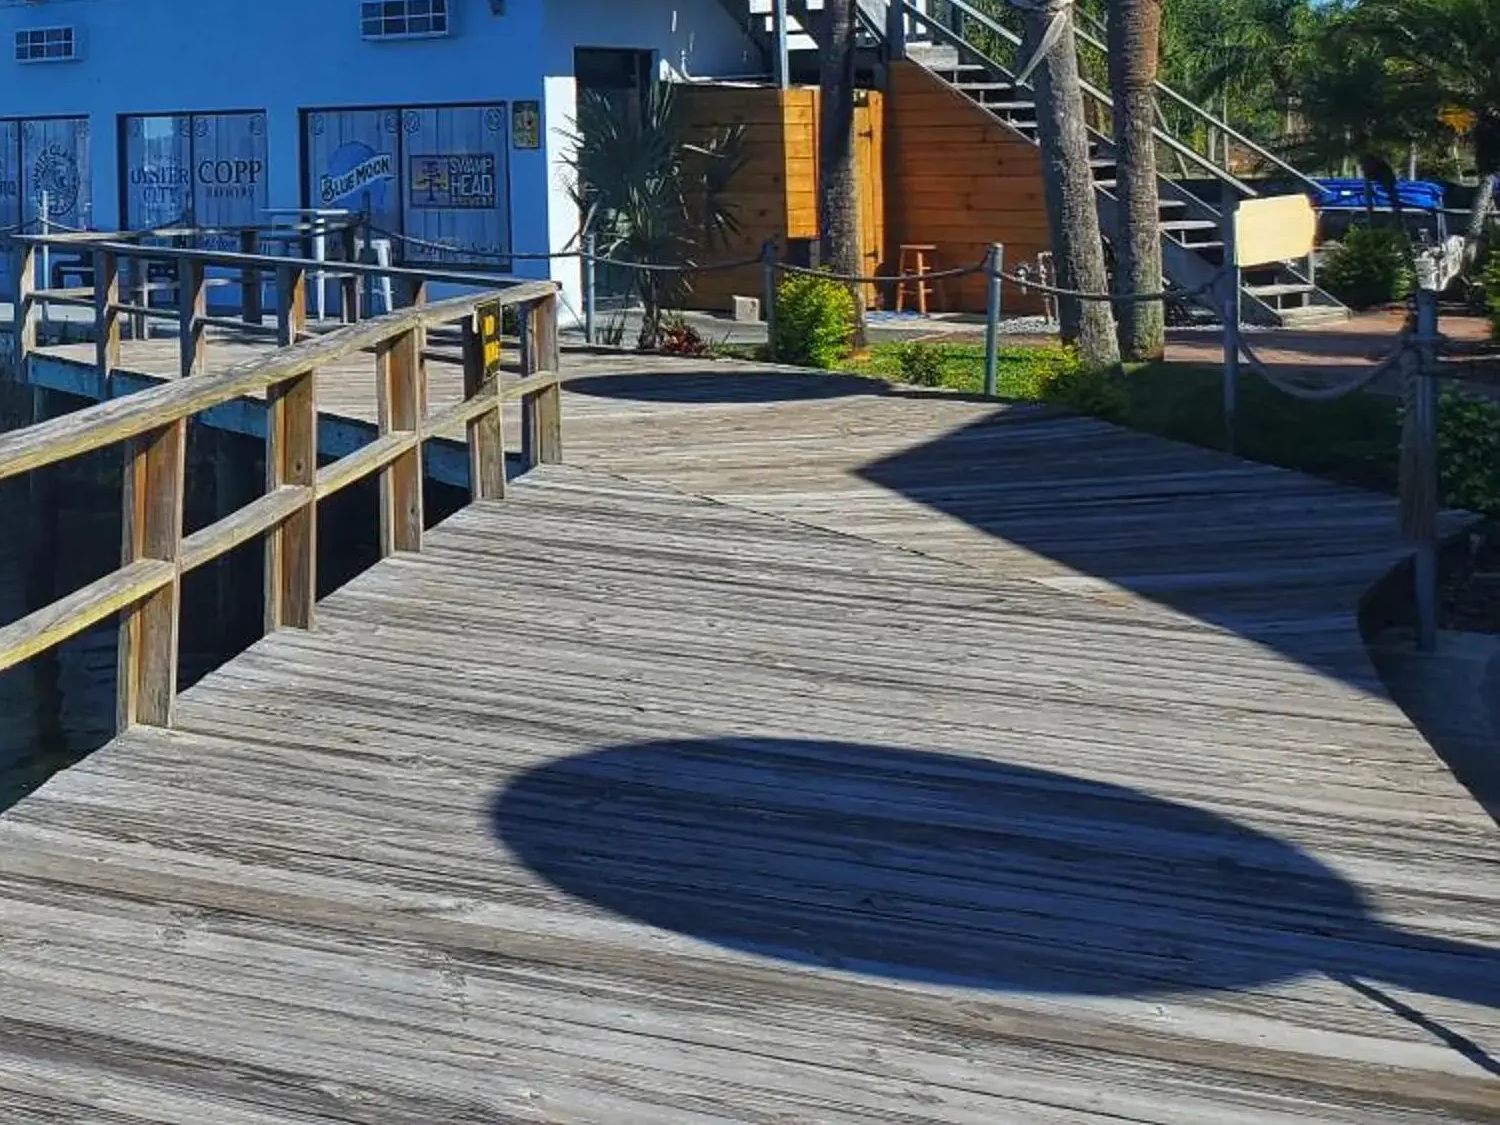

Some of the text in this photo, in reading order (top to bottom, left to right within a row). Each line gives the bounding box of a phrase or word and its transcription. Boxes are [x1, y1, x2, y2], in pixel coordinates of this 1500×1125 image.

[197, 160, 262, 184] COPP
[449, 156, 493, 174] SWAMP
[320, 157, 389, 202] BLUE MOON
[451, 174, 493, 196] HEAD
